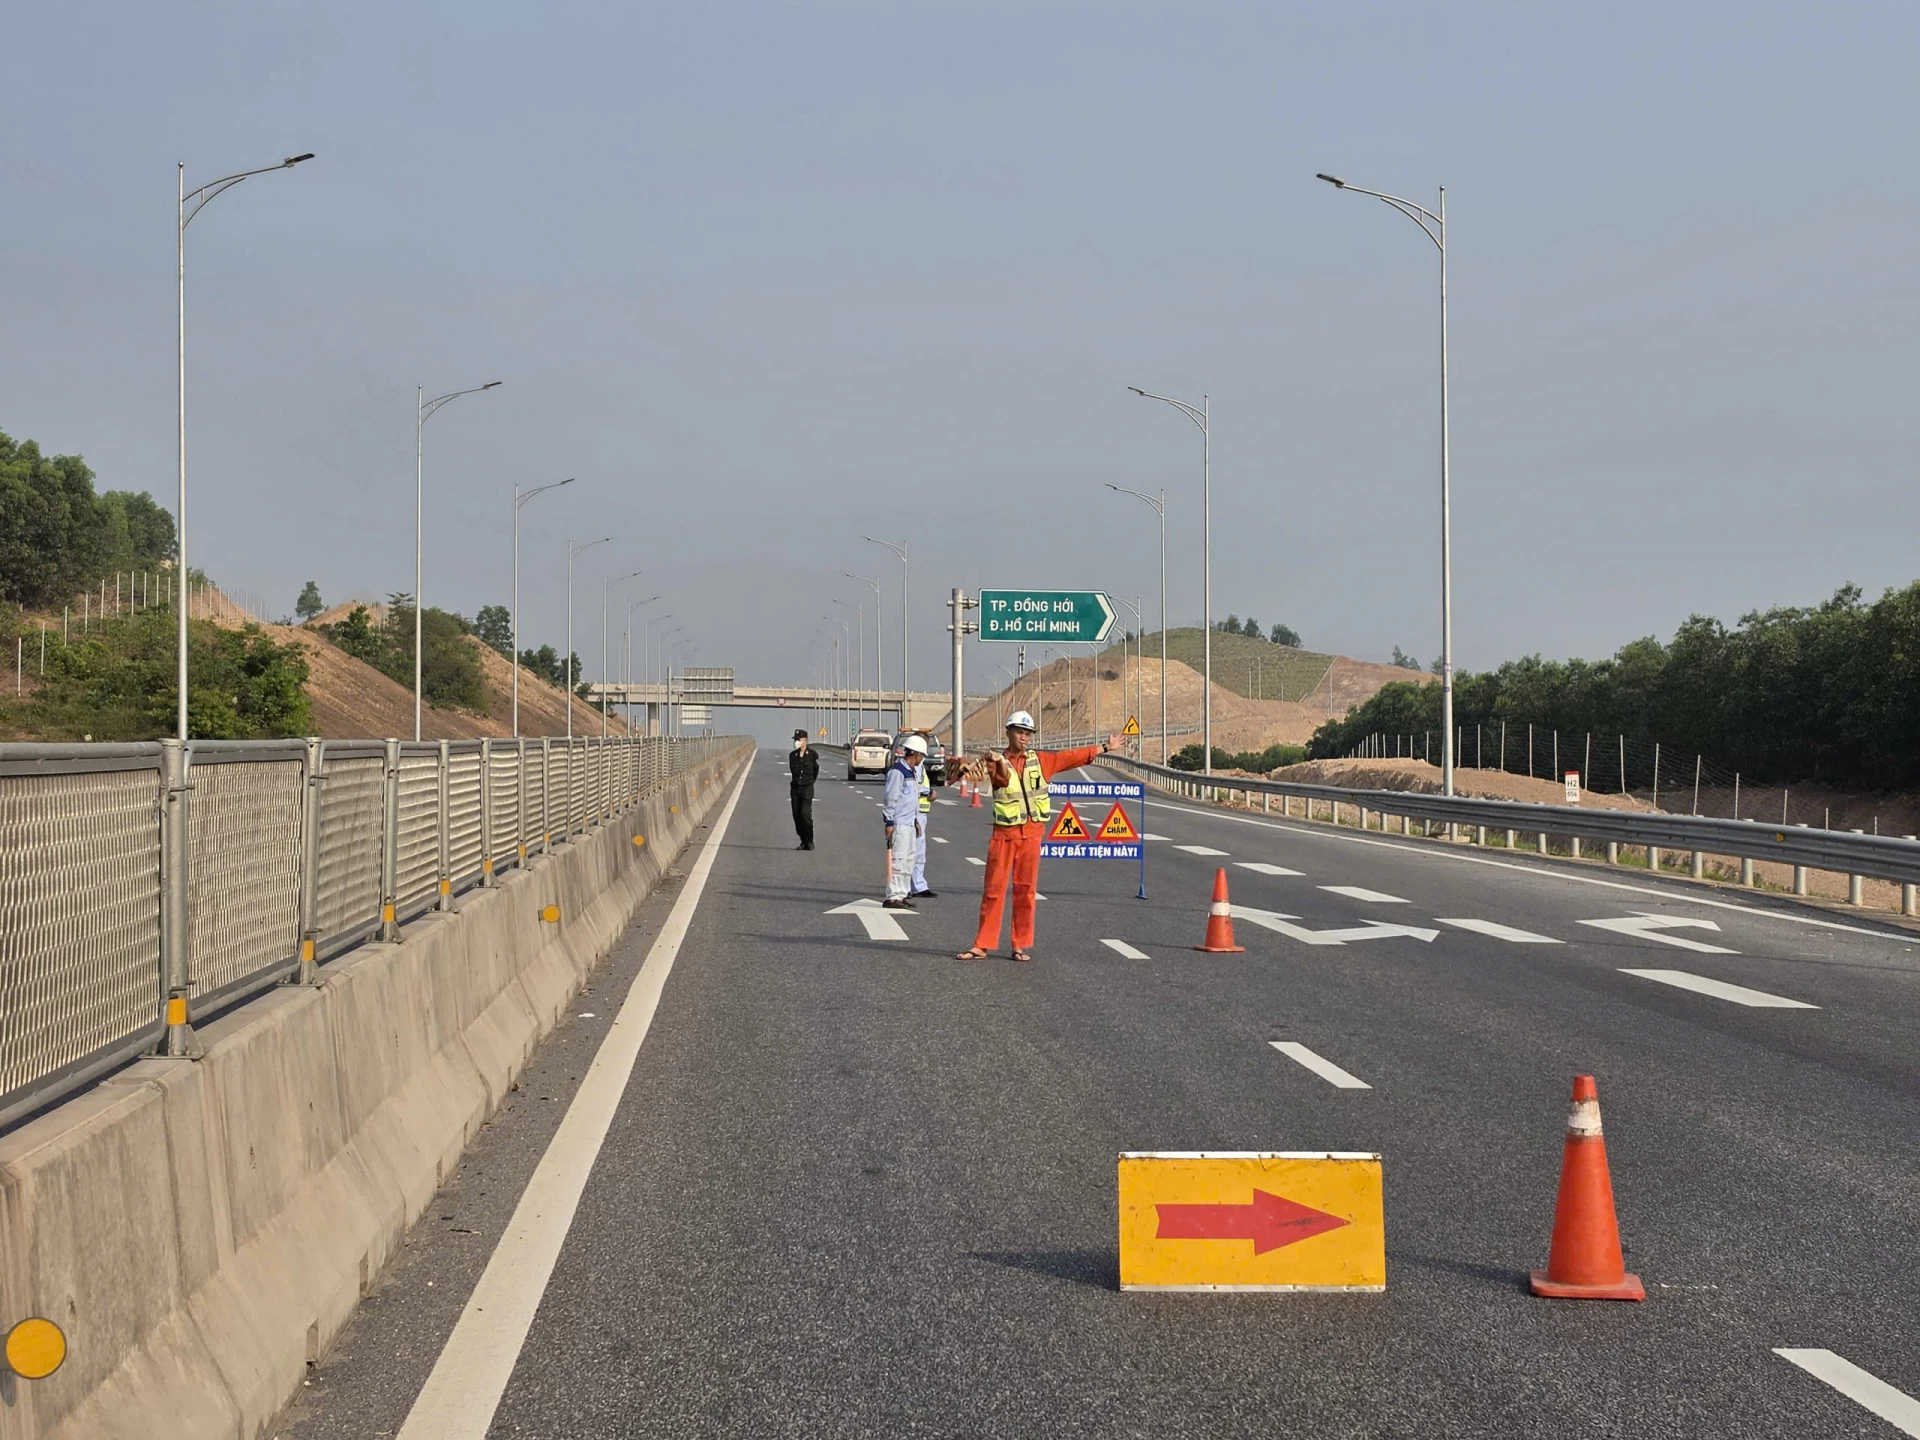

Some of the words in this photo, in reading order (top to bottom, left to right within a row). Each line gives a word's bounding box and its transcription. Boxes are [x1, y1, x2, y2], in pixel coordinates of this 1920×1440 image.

[990, 600, 1011, 612] TP.
[1014, 597, 1048, 612] ĐỒNG
[1053, 598, 1073, 613] HỚI
[1026, 617, 1046, 632] CHÍ
[1049, 621, 1079, 633] MINH
[1048, 782, 1067, 794] ỜNG
[1070, 784, 1095, 795] ĐANG
[1097, 785, 1112, 795] THI
[1114, 784, 1140, 796] CÔNG
[1051, 845, 1066, 858] SỰ
[1068, 844, 1086, 856] BẤT
[1089, 845, 1111, 858] TIỆN
[1113, 845, 1137, 857] NÀY!
